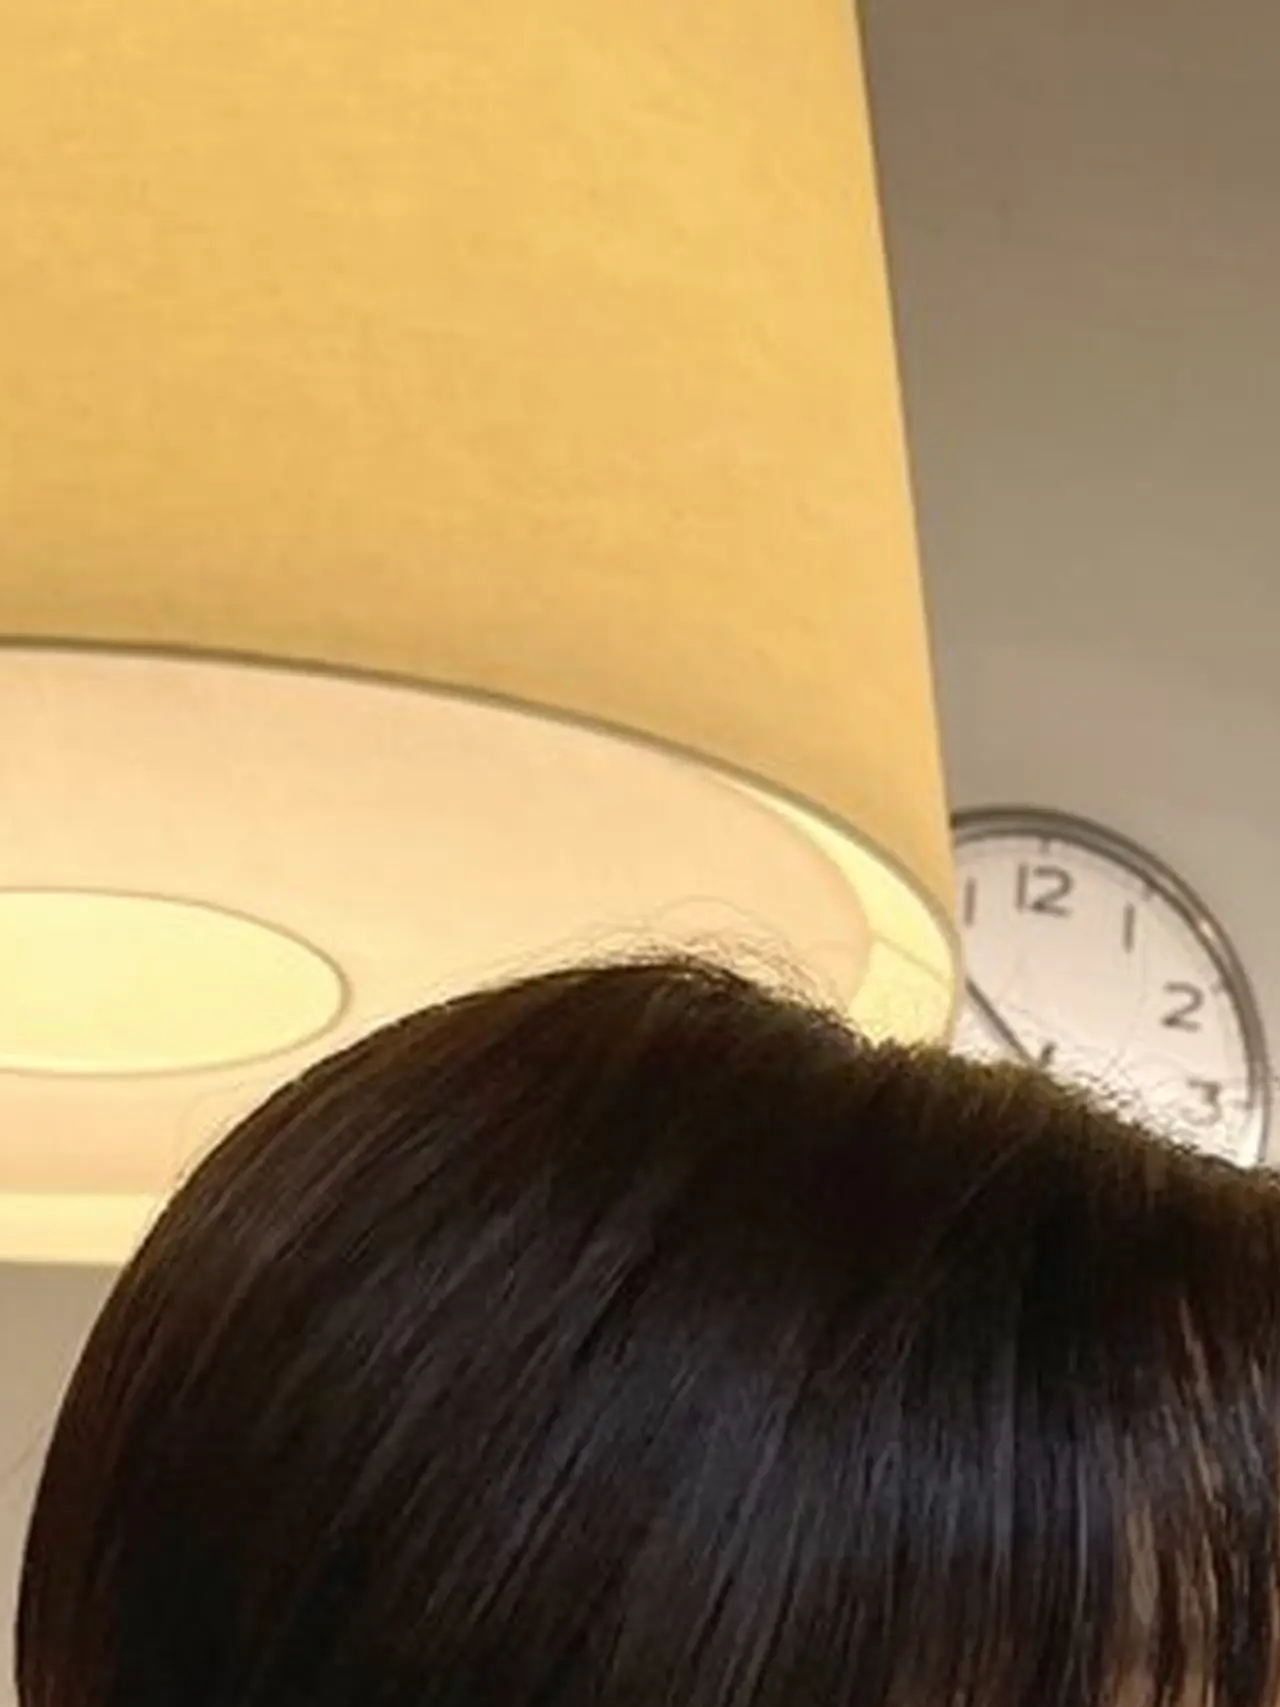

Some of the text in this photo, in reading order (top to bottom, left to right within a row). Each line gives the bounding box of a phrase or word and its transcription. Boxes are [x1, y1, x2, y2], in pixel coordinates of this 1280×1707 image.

[1016, 863, 1074, 917] 12
[1123, 903, 1136, 953] 1
[1161, 980, 1205, 1031] 2
